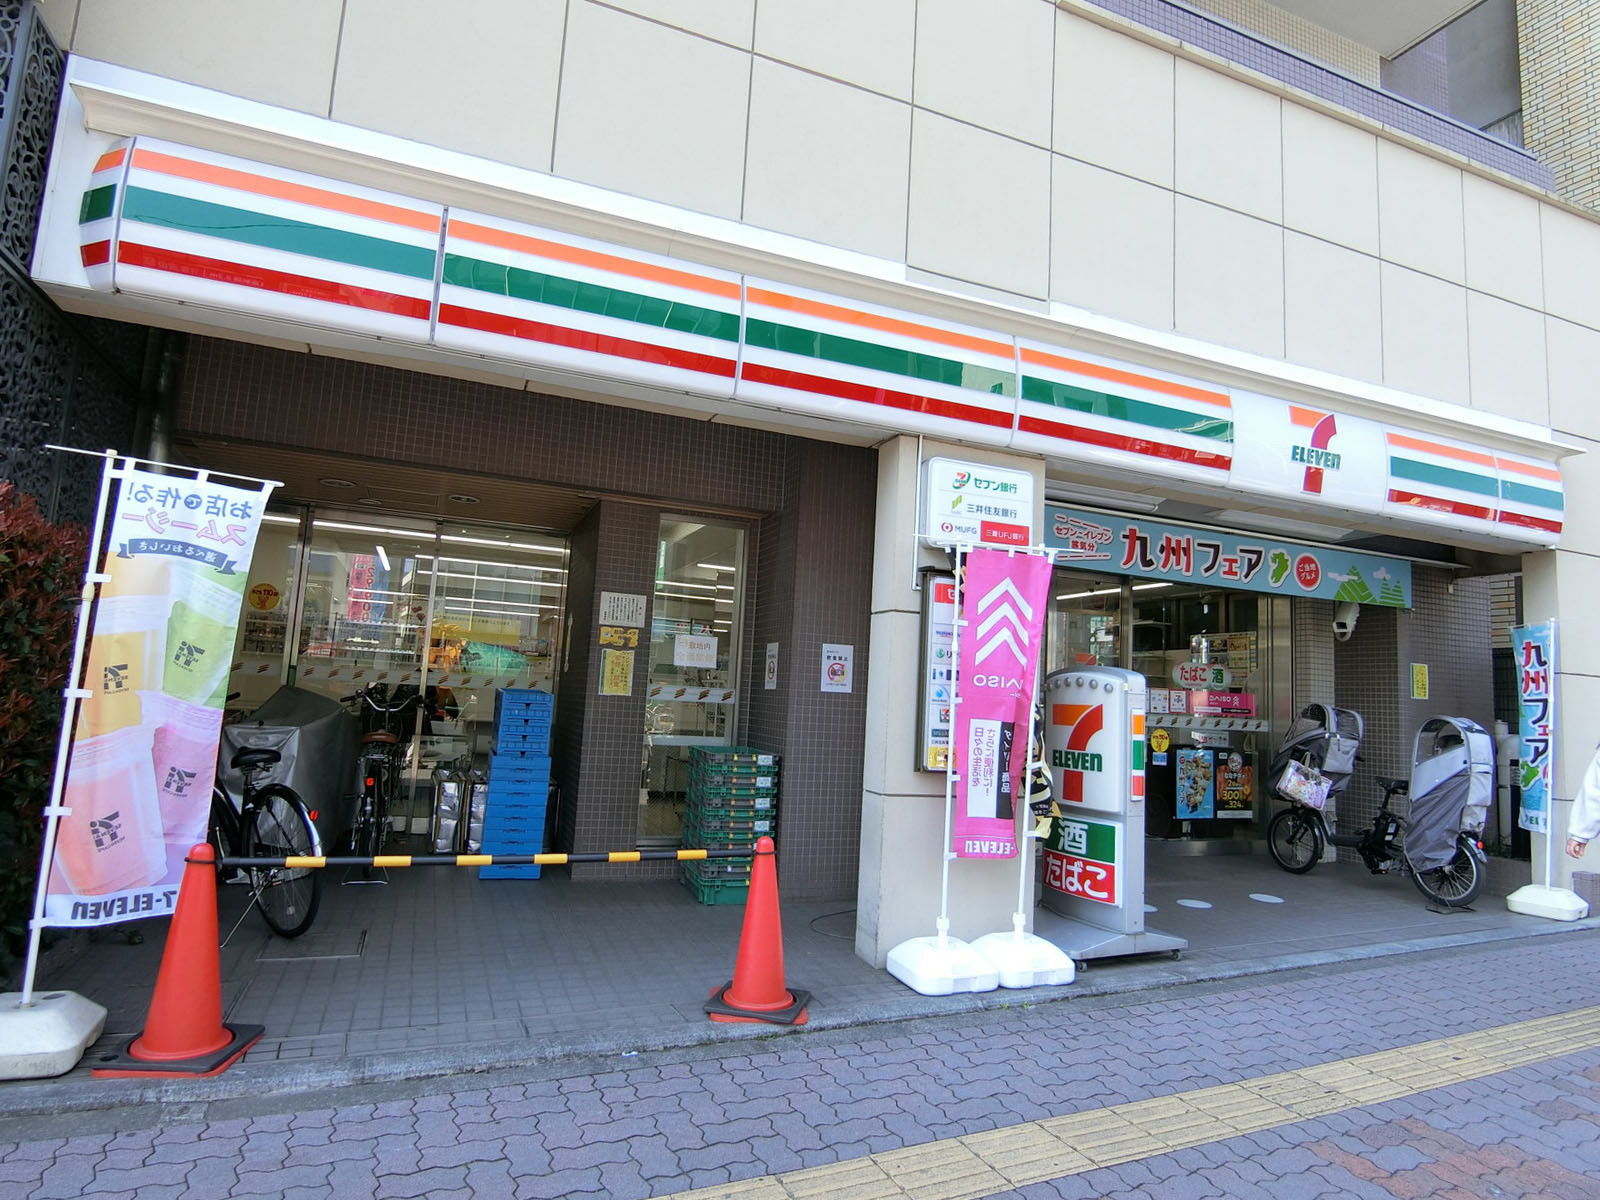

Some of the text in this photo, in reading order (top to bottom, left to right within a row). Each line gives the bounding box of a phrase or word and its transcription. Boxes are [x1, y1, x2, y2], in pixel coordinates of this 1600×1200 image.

[974, 477, 1017, 494] セブン銀行
[967, 503, 1017, 518] 三井住友銀行
[955, 525, 977, 535] MUFG
[985, 529, 1024, 541] 三菱UFJ銀行
[1121, 527, 1263, 580] 九州フェア
[1298, 563, 1317, 572] ご当地
[1300, 571, 1316, 581] グルメ
[1180, 665, 1207, 682] たばこ
[1212, 668, 1224, 683] 酒
[1208, 695, 1232, 703] DAISO
[1521, 641, 1549, 765] 九州フェア
[1057, 818, 1088, 855] 酒
[1046, 854, 1109, 899] たばこ
